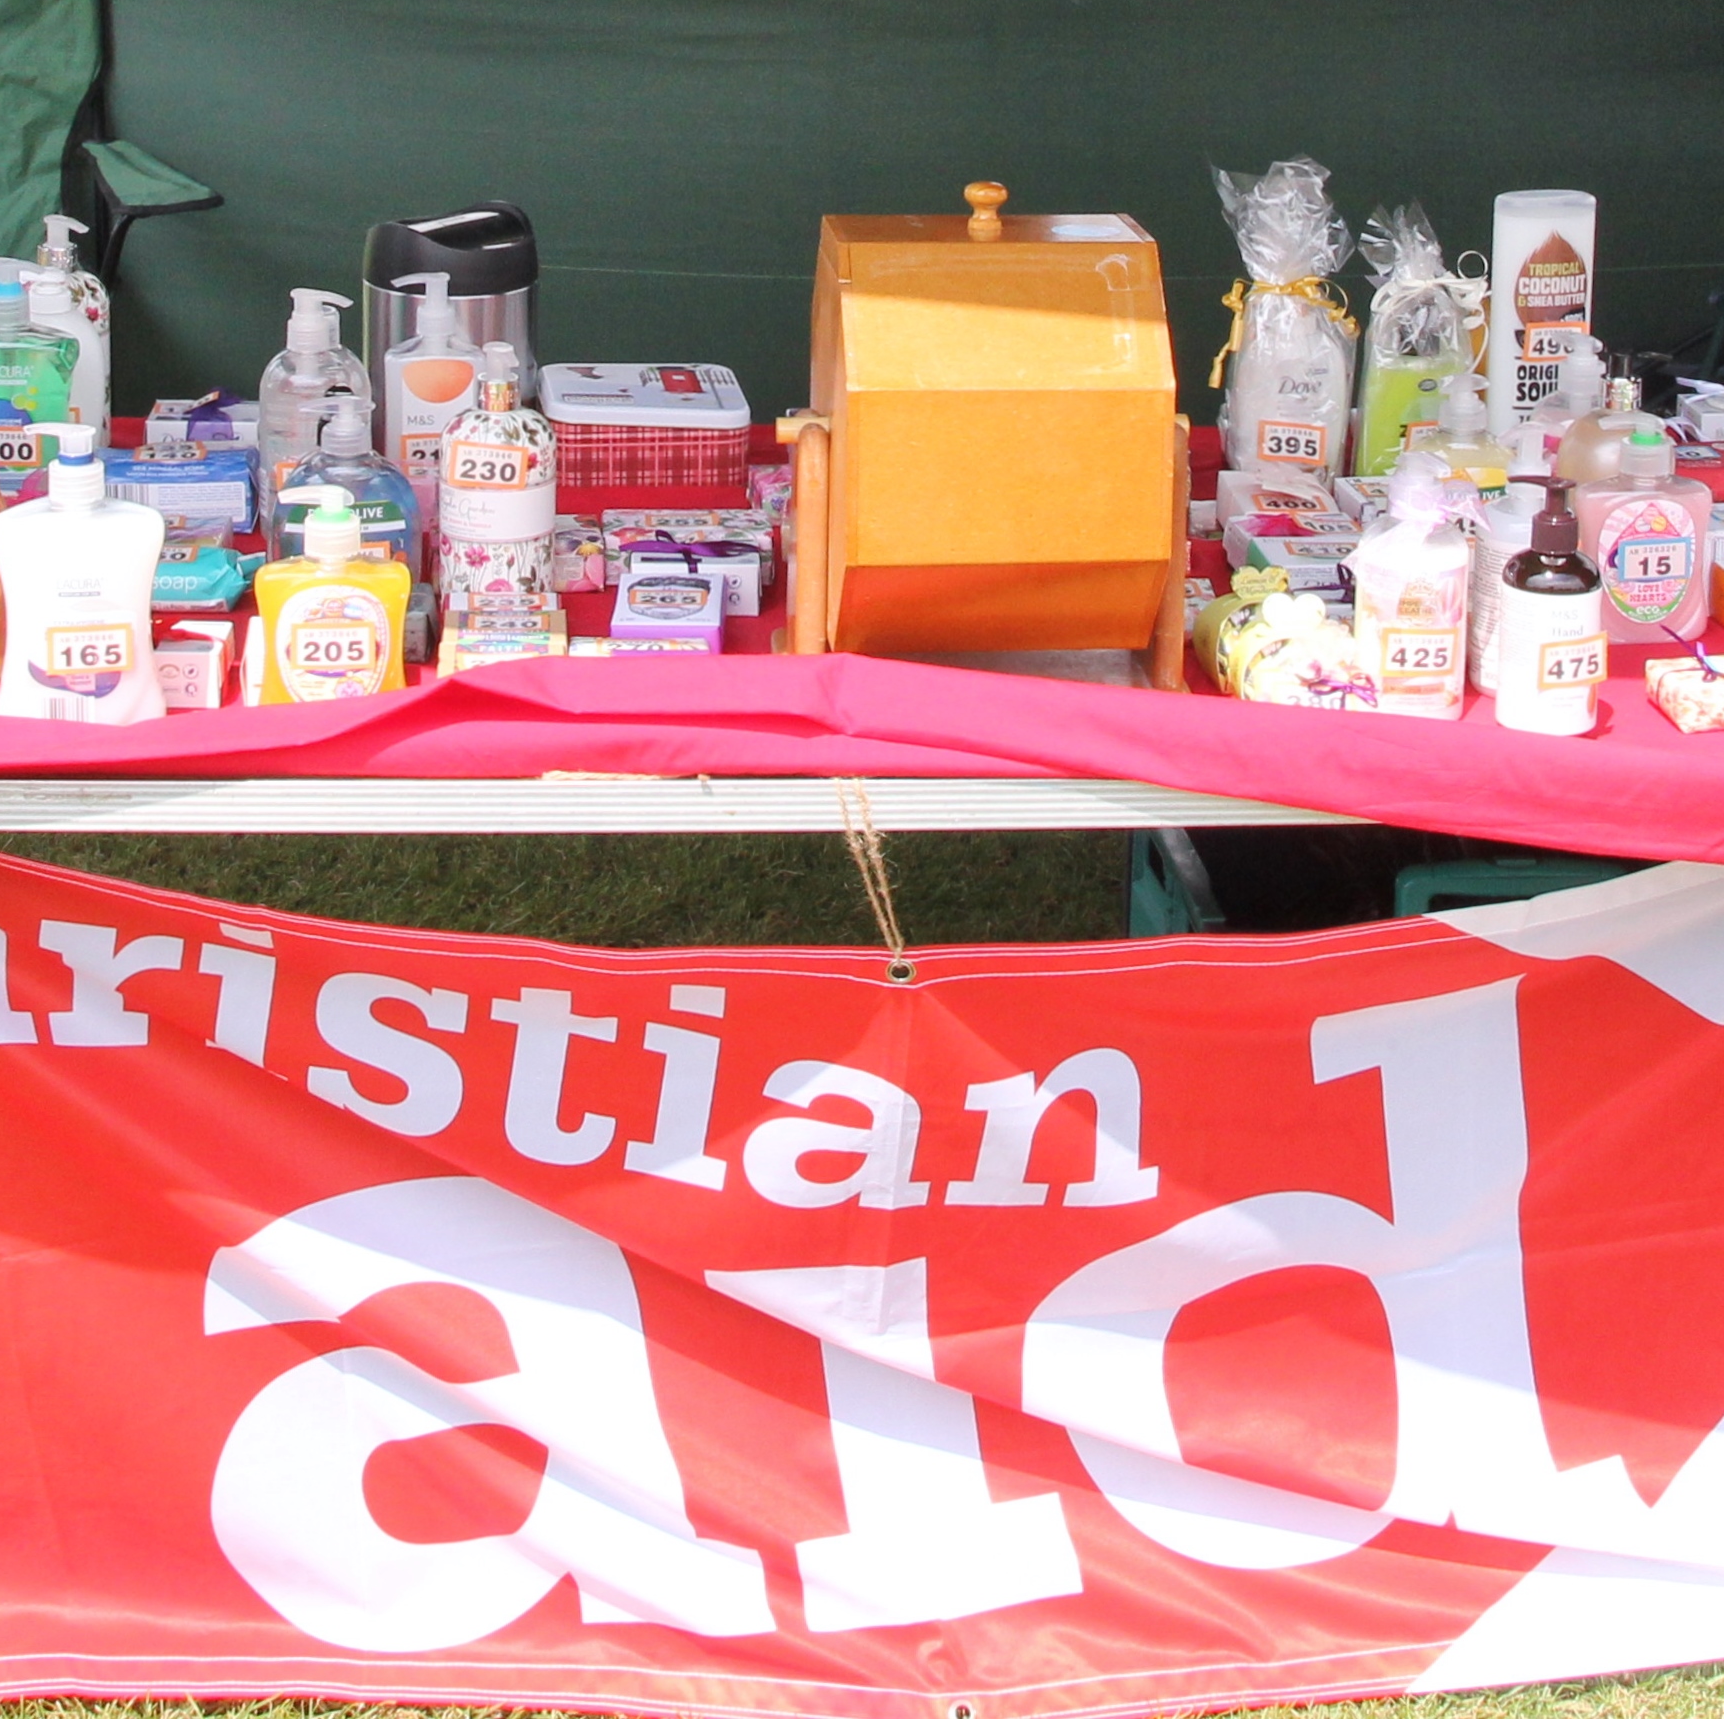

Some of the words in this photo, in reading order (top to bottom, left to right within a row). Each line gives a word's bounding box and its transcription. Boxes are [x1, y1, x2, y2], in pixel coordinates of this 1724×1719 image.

[1528, 261, 1581, 277] TROPICAL
[1517, 274, 1586, 295] COCONUT
[1517, 297, 1526, 307] &
[1526, 295, 1554, 307] SHEA
[1554, 292, 1586, 307] BUTTER
[1516, 364, 1559, 381] ORIGI
[1277, 376, 1322, 395] Dove
[406, 414, 436, 426] M&S
[0, 442, 34, 461] 00
[1268, 435, 1318, 458] 395
[459, 458, 517, 483] 230
[1266, 497, 1317, 510] 400
[1637, 555, 1672, 576] 15
[56, 578, 102, 591] LACURA
[1637, 584, 1661, 593] LOVE
[478, 596, 537, 607] 235
[640, 594, 698, 605] 265
[1629, 593, 1668, 602] HEARTS
[1635, 605, 1661, 615] eco
[479, 619, 539, 630] 240
[1551, 625, 1585, 638] Hand
[60, 643, 123, 668] 165
[302, 640, 365, 663] 205
[1390, 646, 1449, 669] 425
[1546, 652, 1600, 680] 475
[201, 973, 1671, 1653] aid
